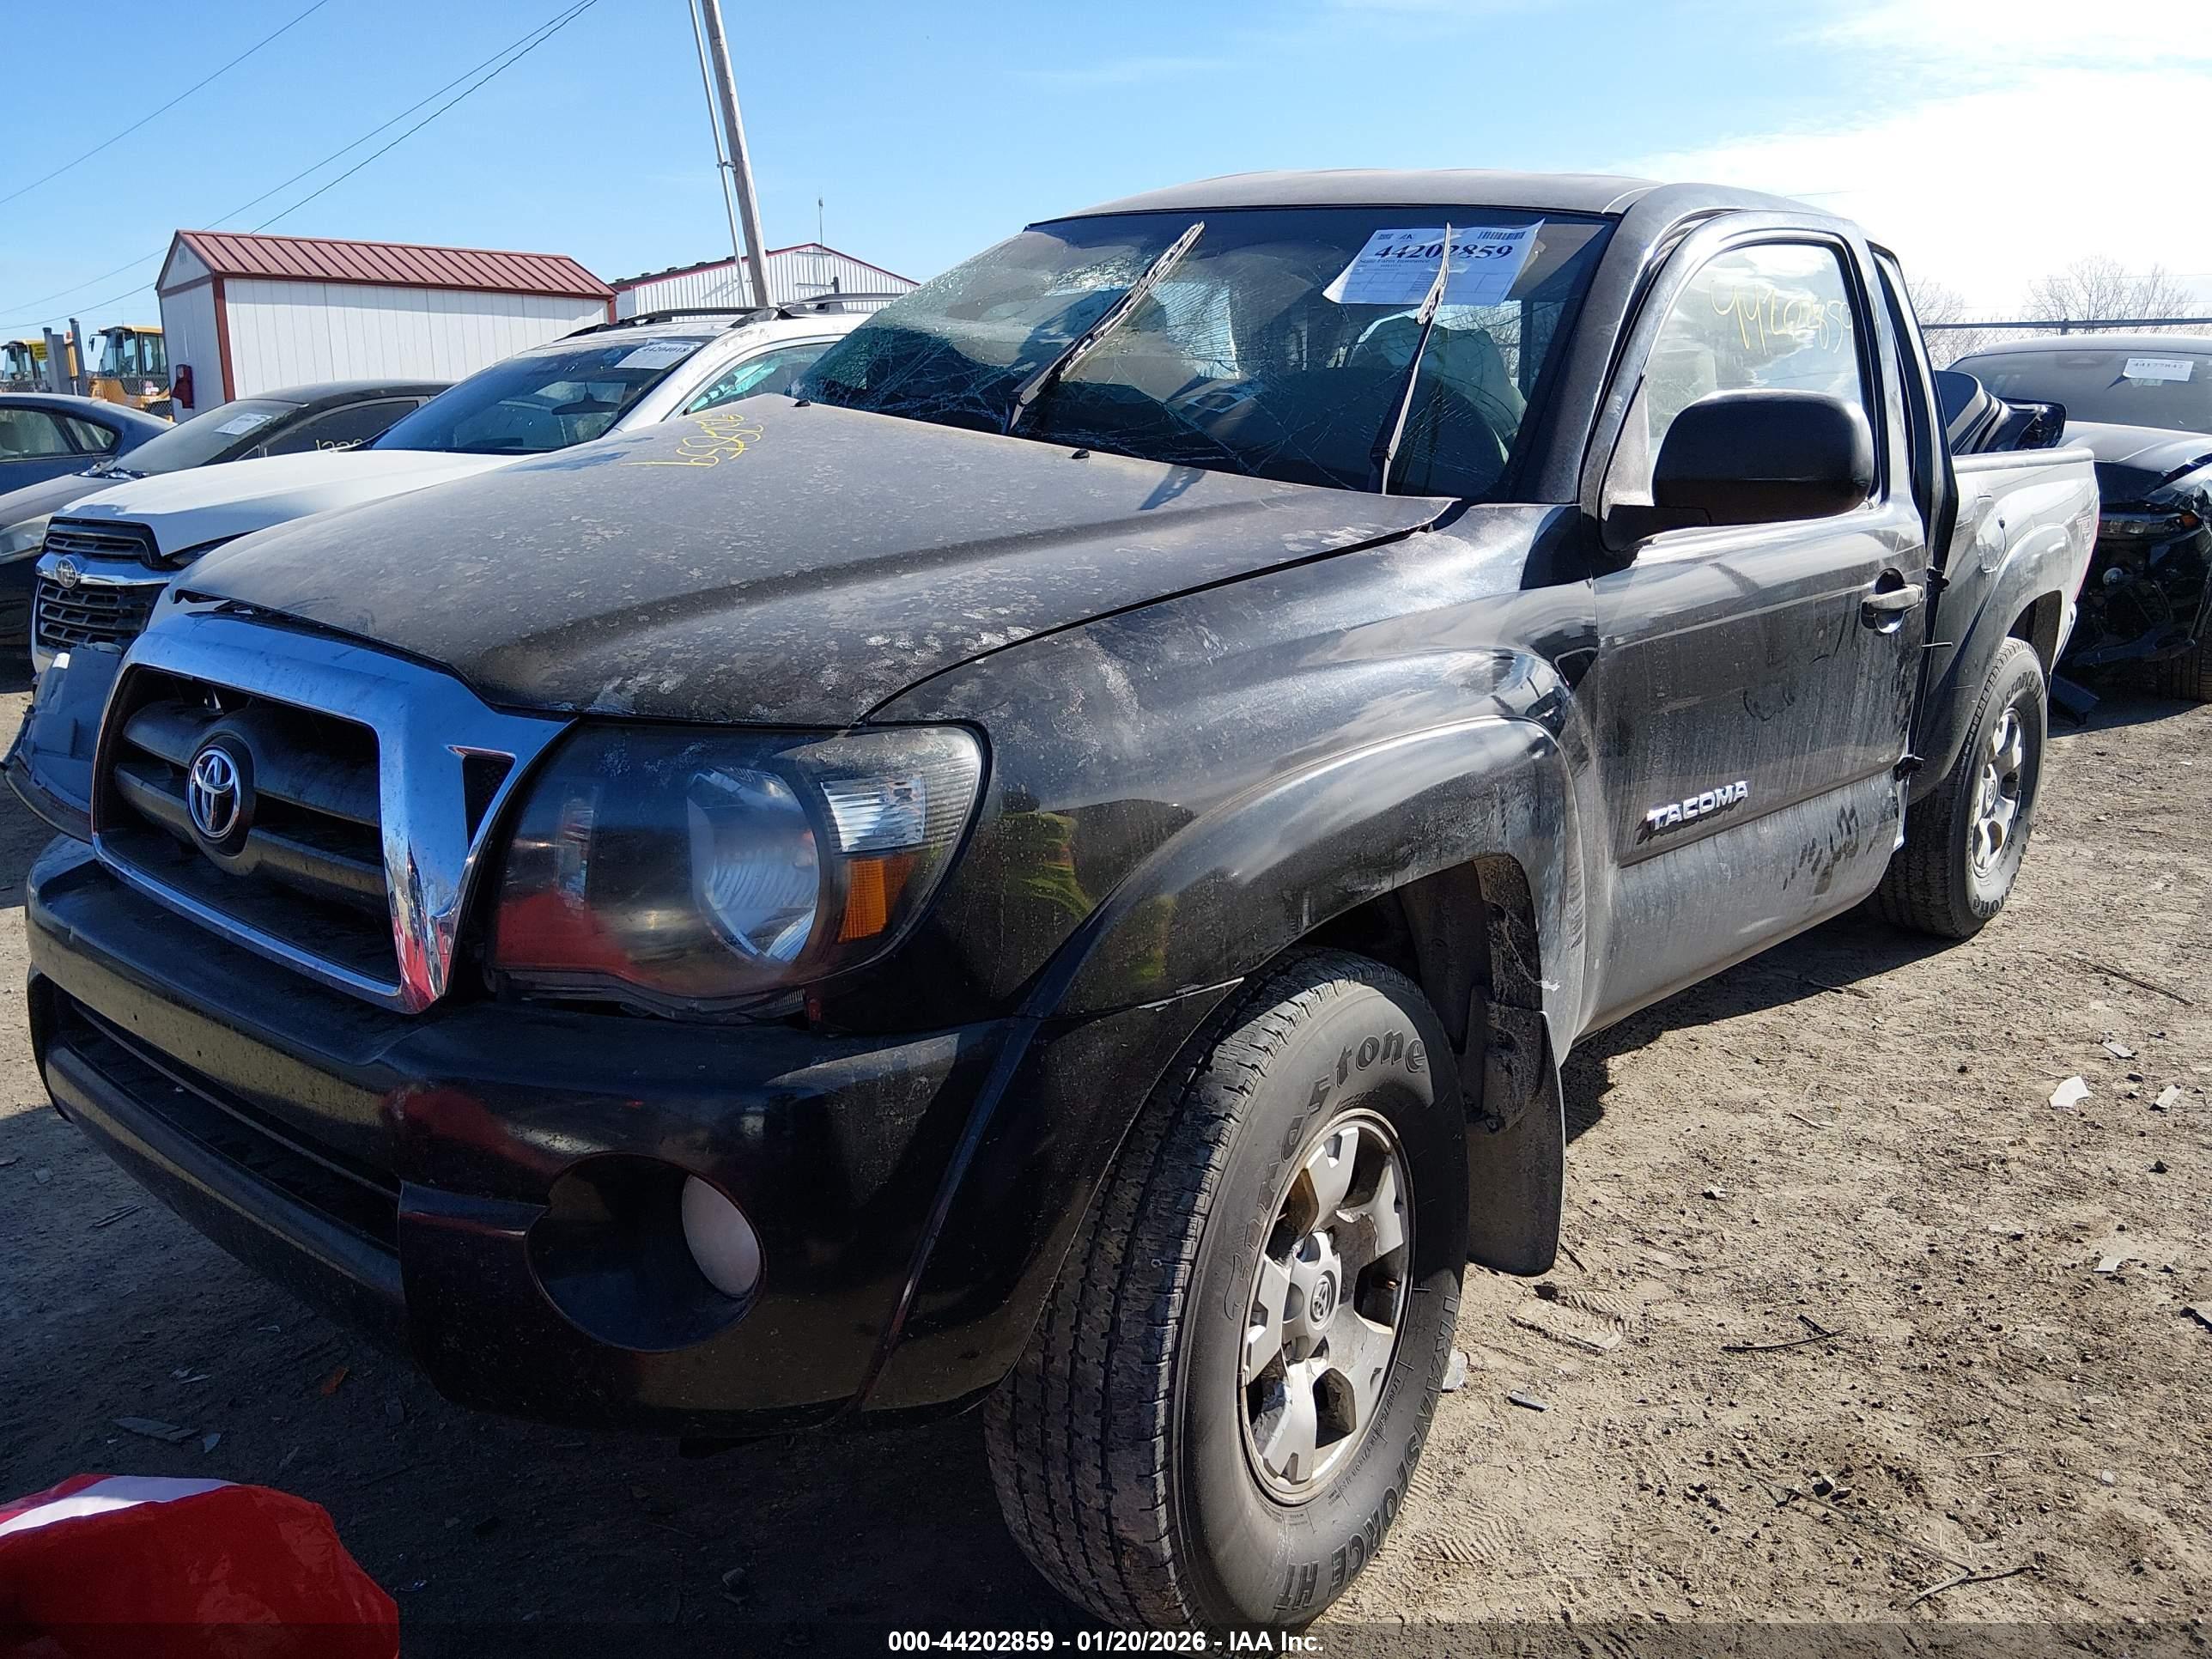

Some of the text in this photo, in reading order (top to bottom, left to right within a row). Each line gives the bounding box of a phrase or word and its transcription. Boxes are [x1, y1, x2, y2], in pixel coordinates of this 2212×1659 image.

[1375, 244, 1513, 258] 44202859
[1647, 781, 1749, 831] TACOMA
[1273, 1295, 1462, 1612] TRANSFORCE HT
